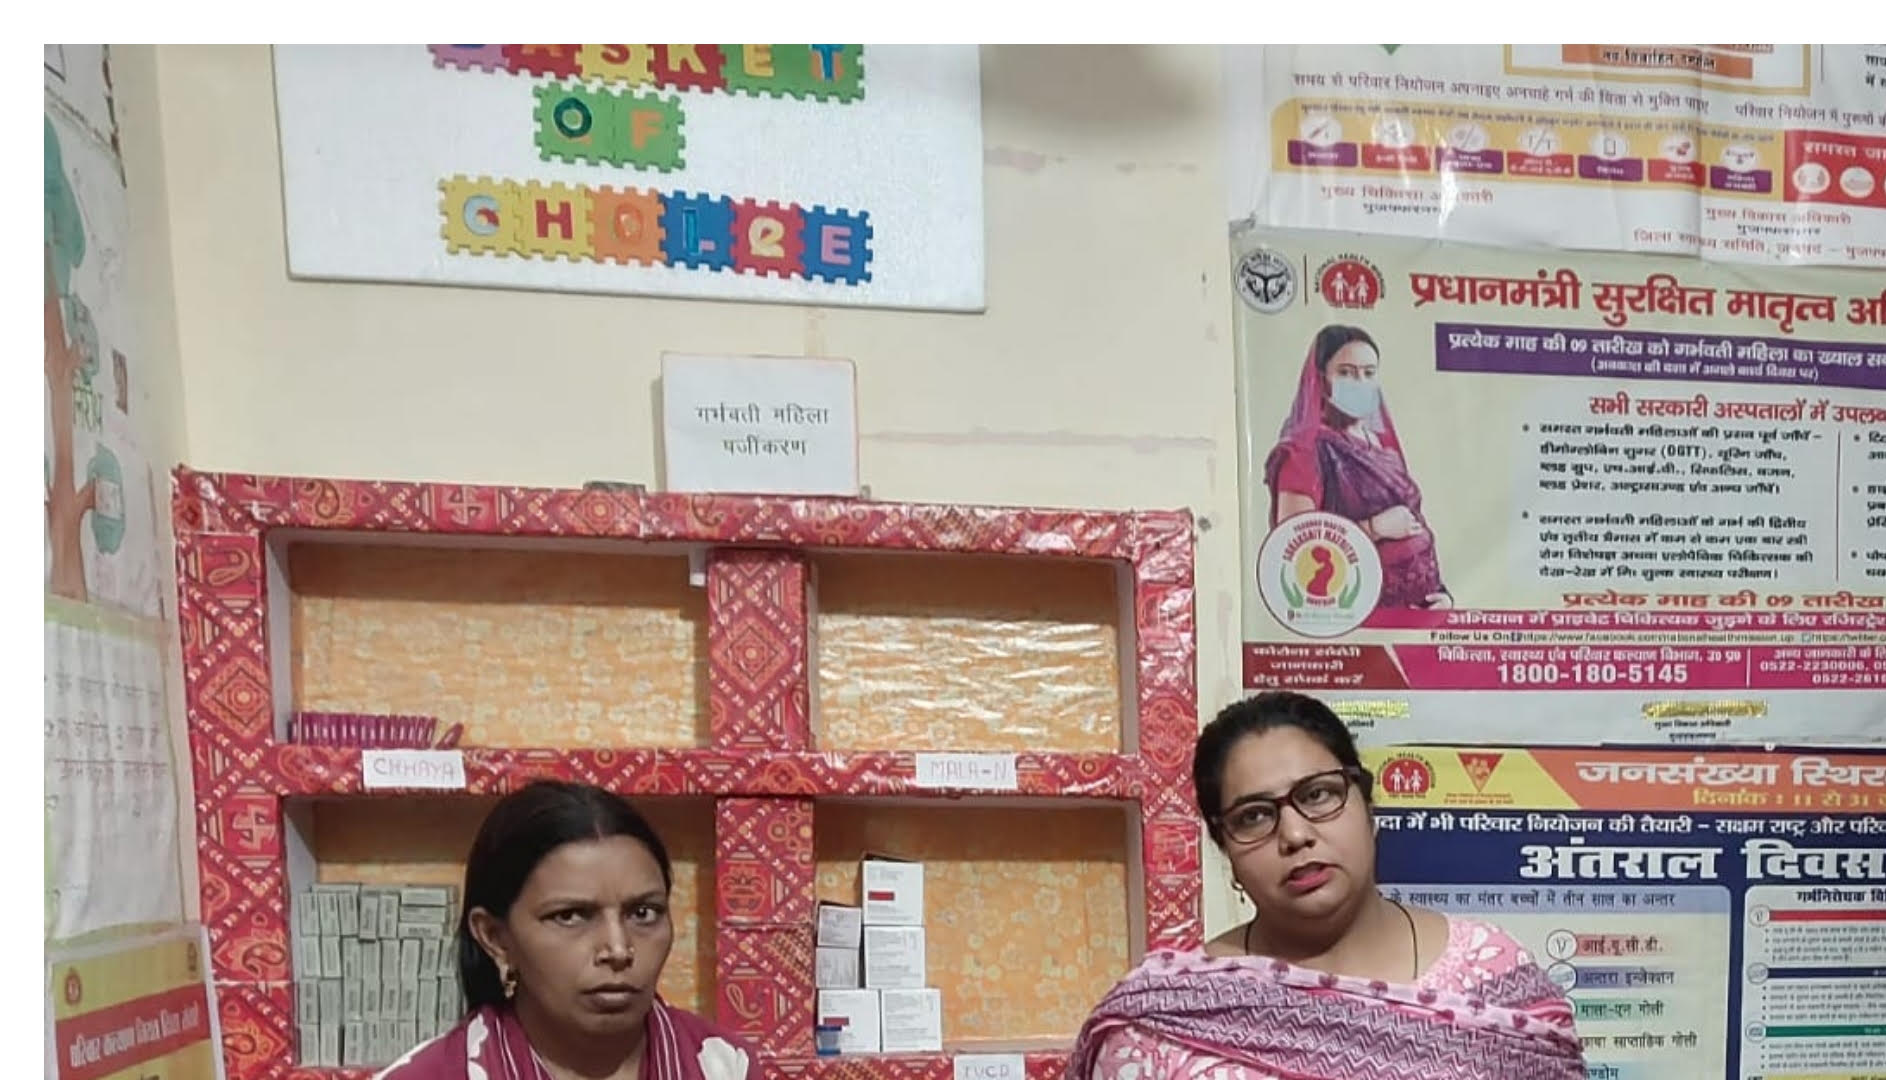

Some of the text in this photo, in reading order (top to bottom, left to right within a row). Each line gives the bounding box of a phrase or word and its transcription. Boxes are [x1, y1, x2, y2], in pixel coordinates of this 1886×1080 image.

[450, 44, 844, 82] SKET
[1294, 73, 1325, 88] समय
[1349, 73, 1390, 89] परिवार
[1395, 75, 1445, 95] नियोजन
[1578, 86, 1595, 103] की
[553, 97, 661, 149] OF
[1735, 103, 1773, 120] परिवार
[463, 194, 852, 266] CHOICE
[1409, 268, 1583, 309] प्रधानमंत्री
[1591, 274, 1717, 327] सुरक्षित
[1726, 288, 1838, 333] मातृत्व
[1449, 329, 1501, 350] प्रत्येक
[1505, 336, 1538, 352] माह
[1542, 332, 1566, 353] की
[1592, 335, 1643, 356] तारीख
[1647, 337, 1669, 357] को
[1674, 337, 1732, 359] गर्भवती
[1737, 341, 1789, 362] महिला
[1793, 347, 1814, 363] का
[1818, 350, 1863, 367] ख्याल
[695, 402, 830, 425] गर्भवती महिला
[1588, 391, 1630, 415] सभी
[1637, 393, 1708, 417] सरकारी
[1714, 397, 1807, 421] अस्पतालों
[1809, 399, 1827, 422] में
[1562, 588, 1885, 609] प्रत्येक माह की 09 तारीख
[1447, 609, 1523, 626] अभियान
[1498, 663, 1688, 683] 1800-180-5145
[1575, 756, 1779, 787] जनसंख्या
[1406, 811, 1428, 831] में
[1430, 812, 1454, 832] भी
[1459, 814, 1522, 832] परिवार
[1527, 814, 1603, 833] नियोजन
[1609, 814, 1634, 833] की
[1641, 815, 1693, 834] तैयारी
[1715, 818, 1765, 834] सक्षम
[1769, 819, 1807, 837] राष्ट्र
[1810, 817, 1844, 834] और
[1519, 836, 1724, 879] अंतराल
[1455, 891, 1470, 906] का
[1622, 892, 1636, 906] का
[1582, 969, 1619, 985] अन्तरा
[1639, 1000, 1665, 1017] गोली
[1671, 1030, 1698, 1049] गोली
